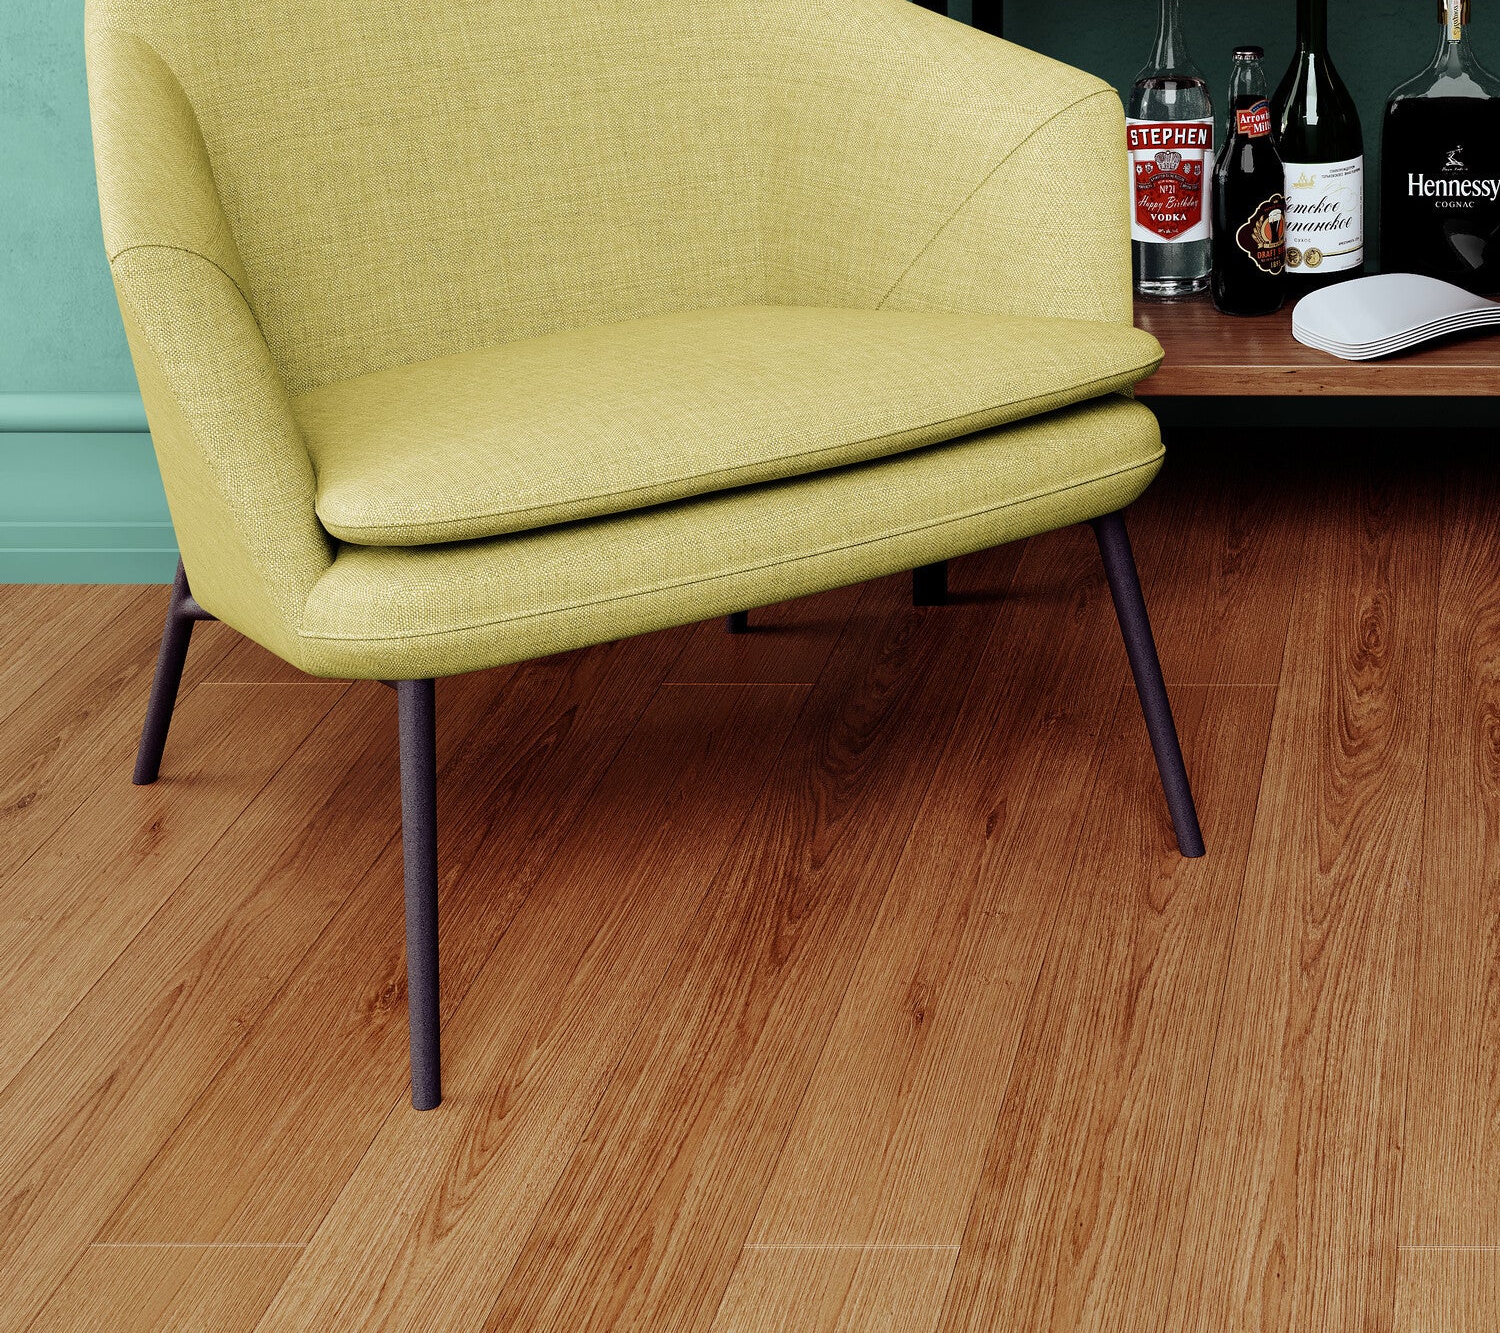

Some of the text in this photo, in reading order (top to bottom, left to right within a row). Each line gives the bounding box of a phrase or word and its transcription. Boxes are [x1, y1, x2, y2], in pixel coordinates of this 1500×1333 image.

[1130, 128, 1208, 146] STEPHEN
[1138, 195, 1199, 213] Happy Birthday
[1150, 213, 1187, 222] VODKA
[1257, 245, 1277, 259] DRAFT
